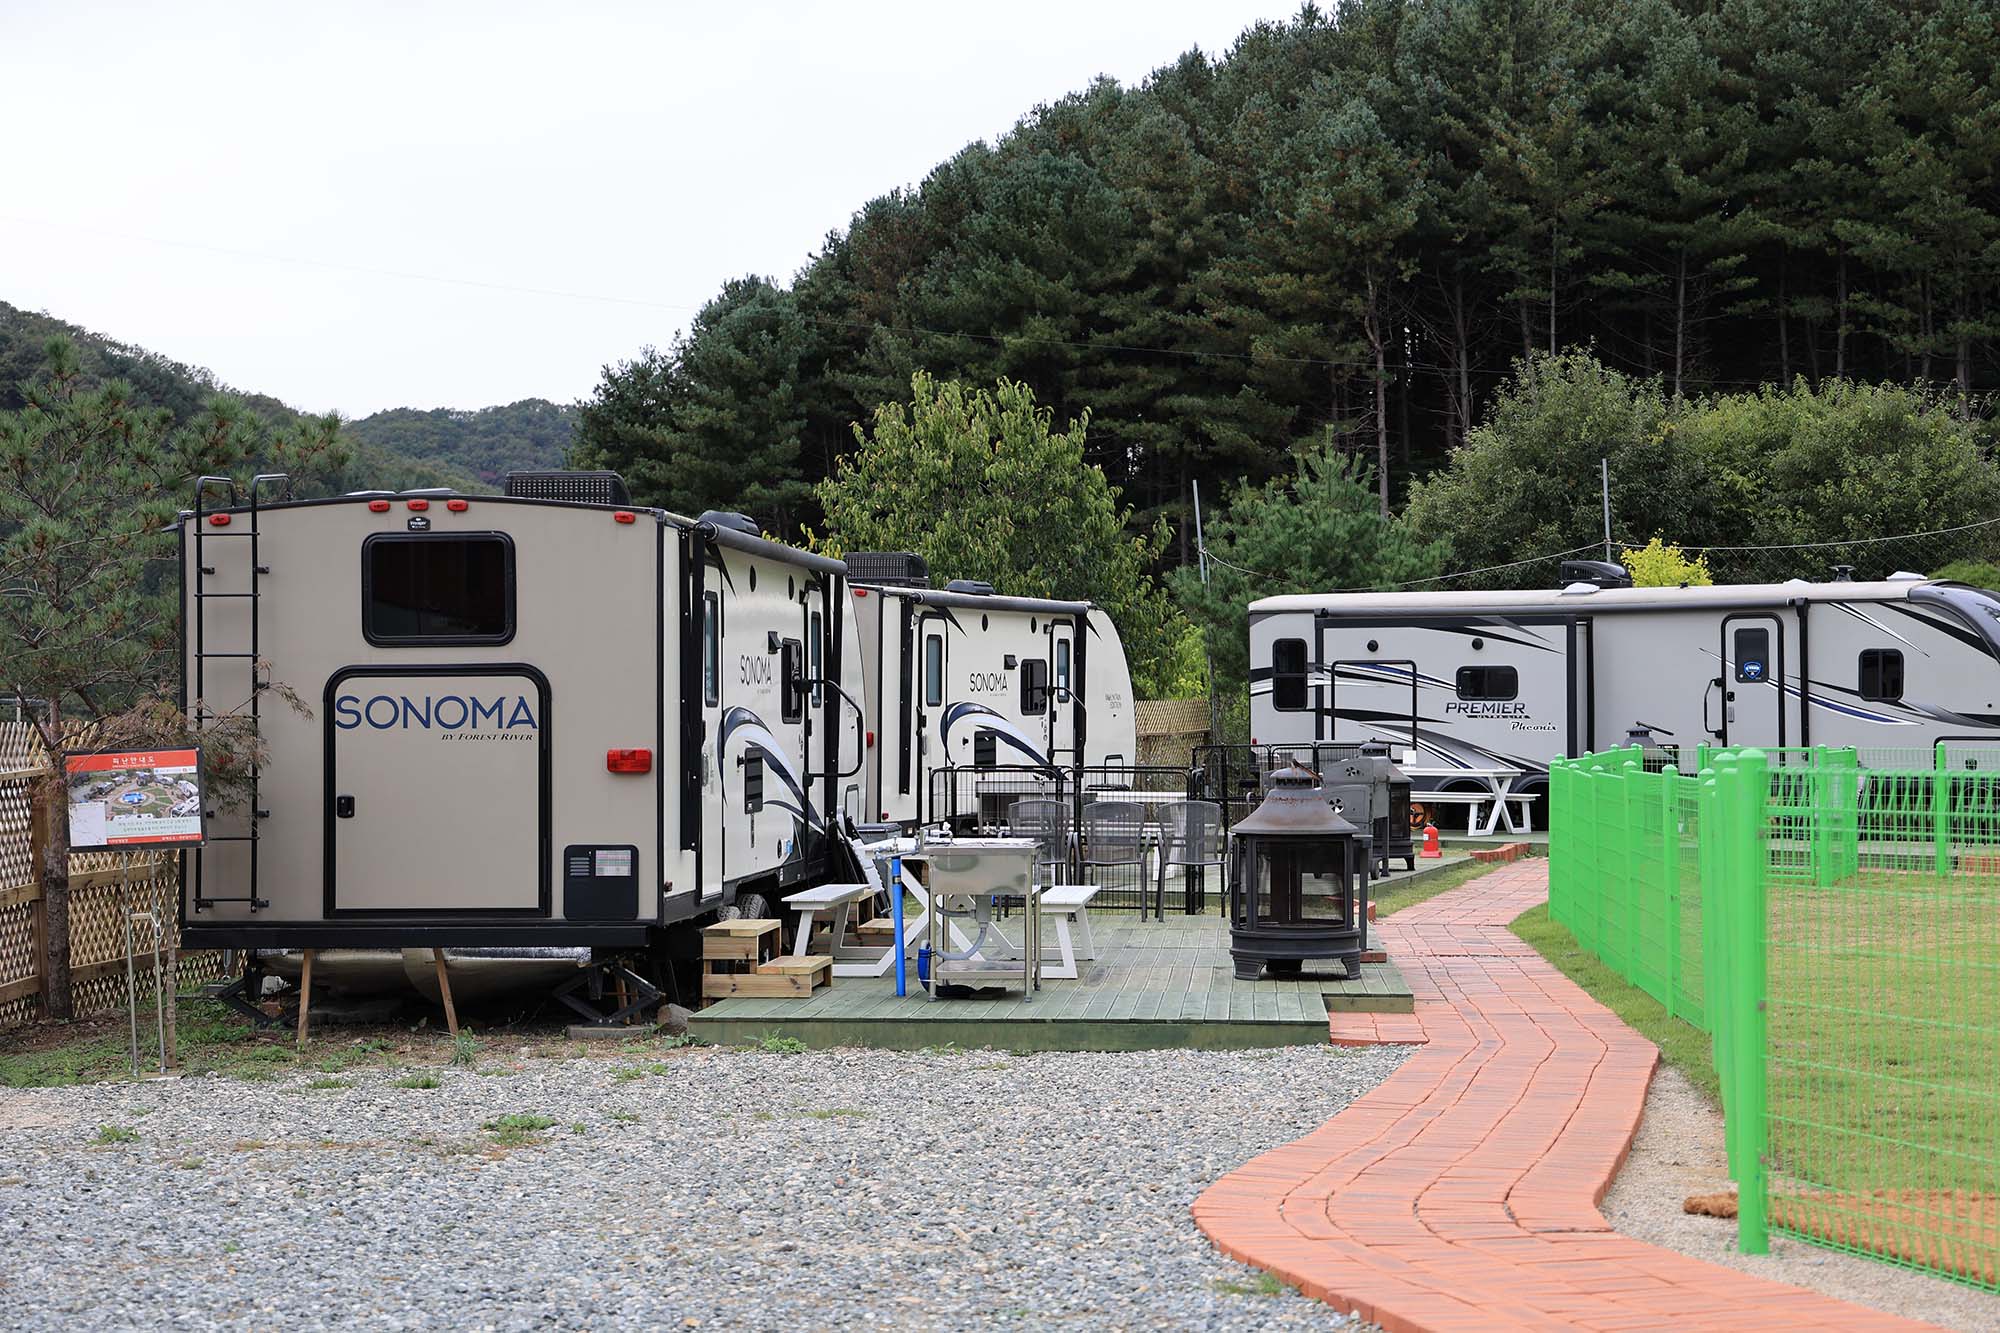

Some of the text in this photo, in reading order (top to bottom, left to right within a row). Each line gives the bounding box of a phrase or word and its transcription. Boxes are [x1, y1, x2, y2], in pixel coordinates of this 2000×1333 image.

[740, 654, 772, 686] SONOMA
[969, 672, 1008, 692] SONOMA
[335, 695, 538, 730] SONOMA
[1445, 702, 1526, 714] PREMIER
[458, 732, 499, 741] FOREST
[500, 732, 534, 741] RIVER
